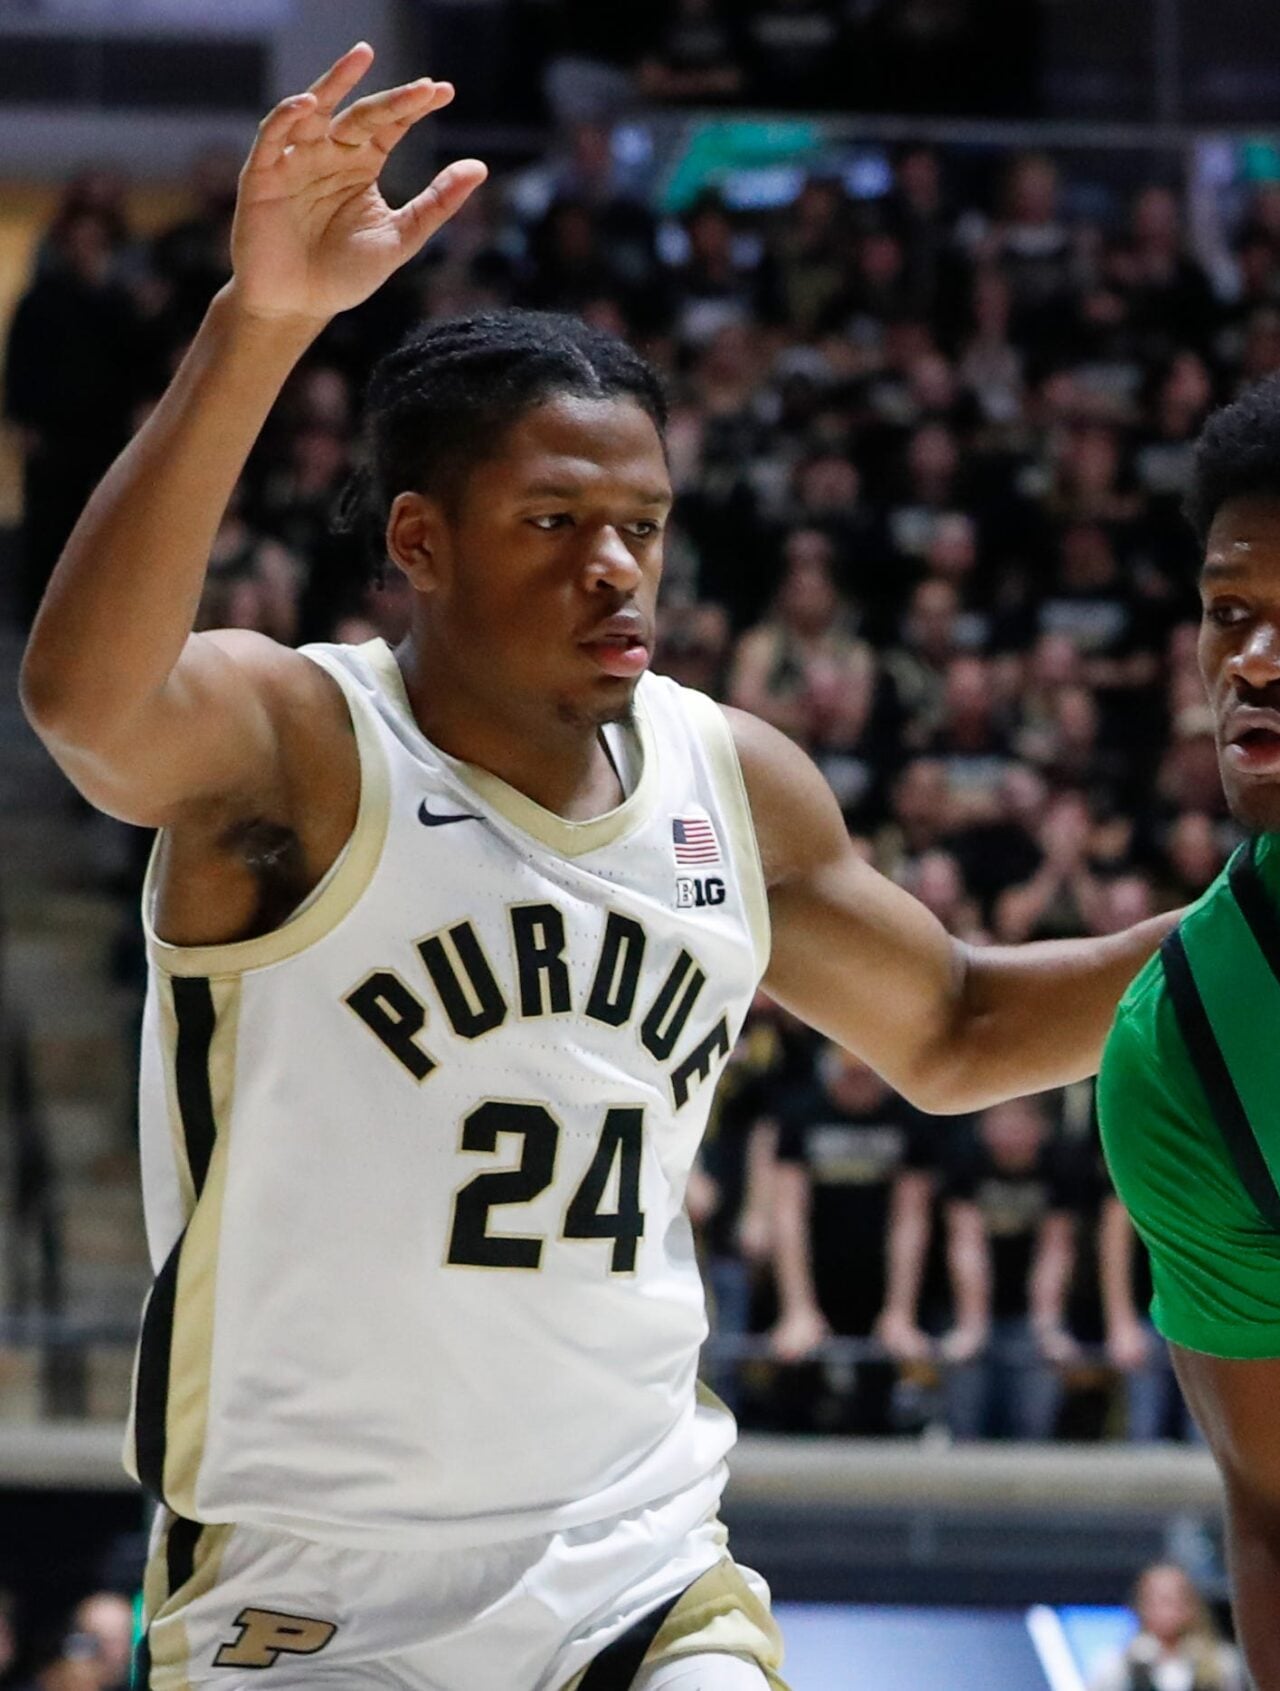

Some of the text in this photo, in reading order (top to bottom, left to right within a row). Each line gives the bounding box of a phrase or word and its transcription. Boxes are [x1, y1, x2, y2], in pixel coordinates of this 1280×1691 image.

[342, 901, 732, 1114] PURDUE
[443, 1098, 647, 1277] 24
[212, 1607, 338, 1669] P
